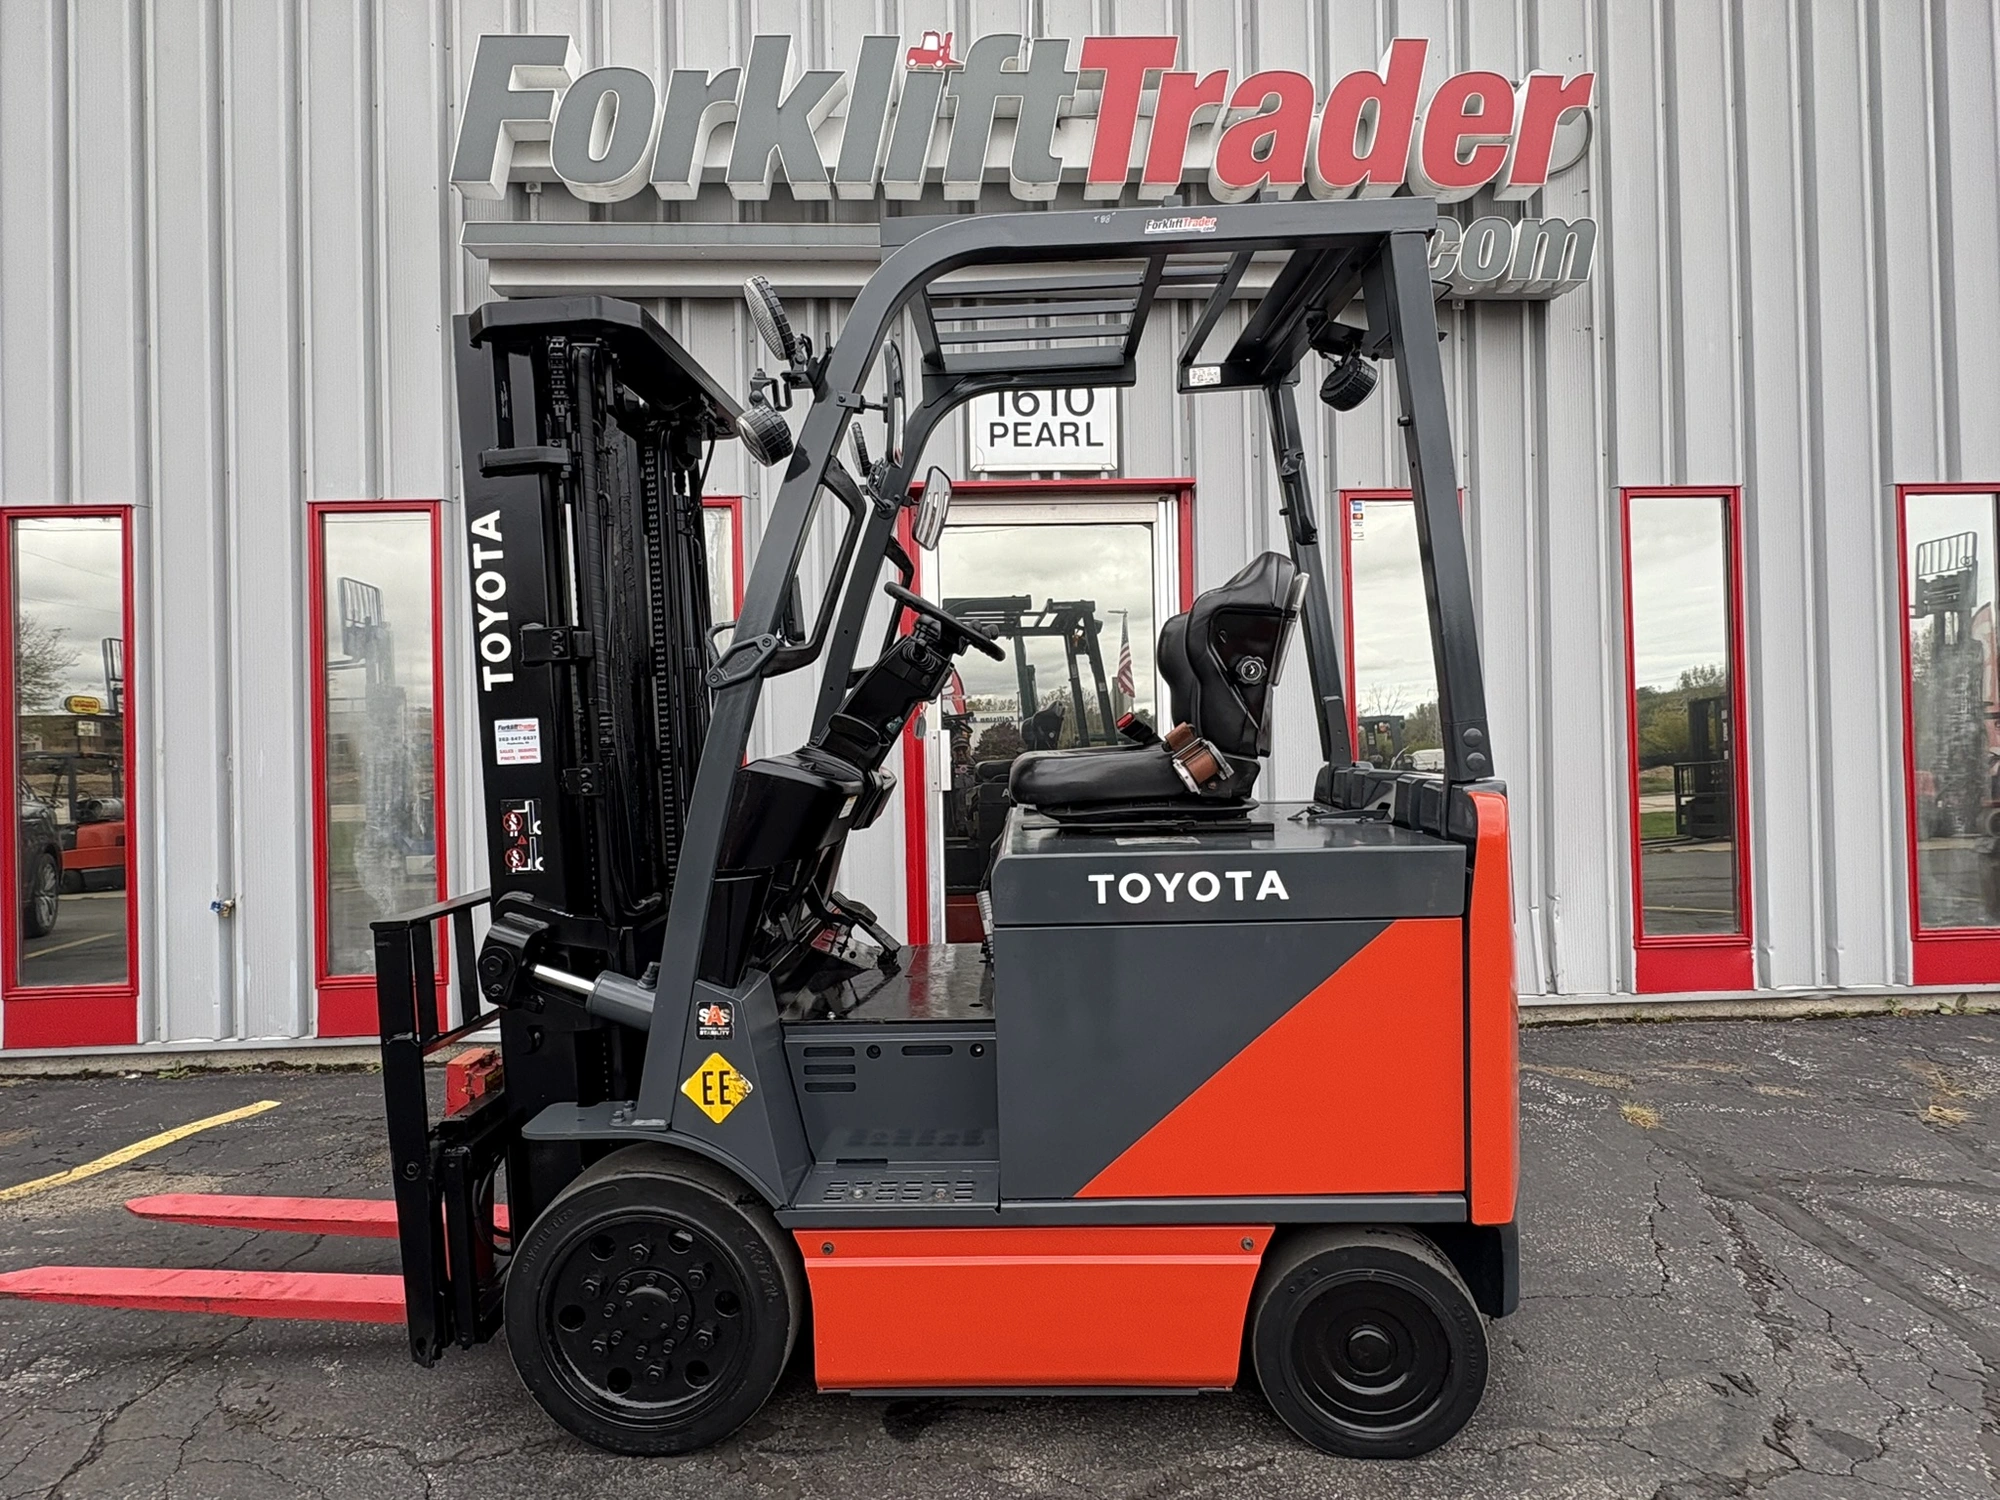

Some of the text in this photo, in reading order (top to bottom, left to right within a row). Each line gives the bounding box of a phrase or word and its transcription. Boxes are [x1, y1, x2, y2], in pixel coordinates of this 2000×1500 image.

[450, 33, 1595, 188] ForkliftTrader
[1146, 217, 1216, 230] ForkliftTrader
[989, 422, 1104, 447] PEARL
[471, 509, 514, 692] TOYOTA
[1088, 870, 1289, 904] TOYOTA
[698, 1005, 731, 1026] SAS
[702, 1070, 731, 1105] EE
